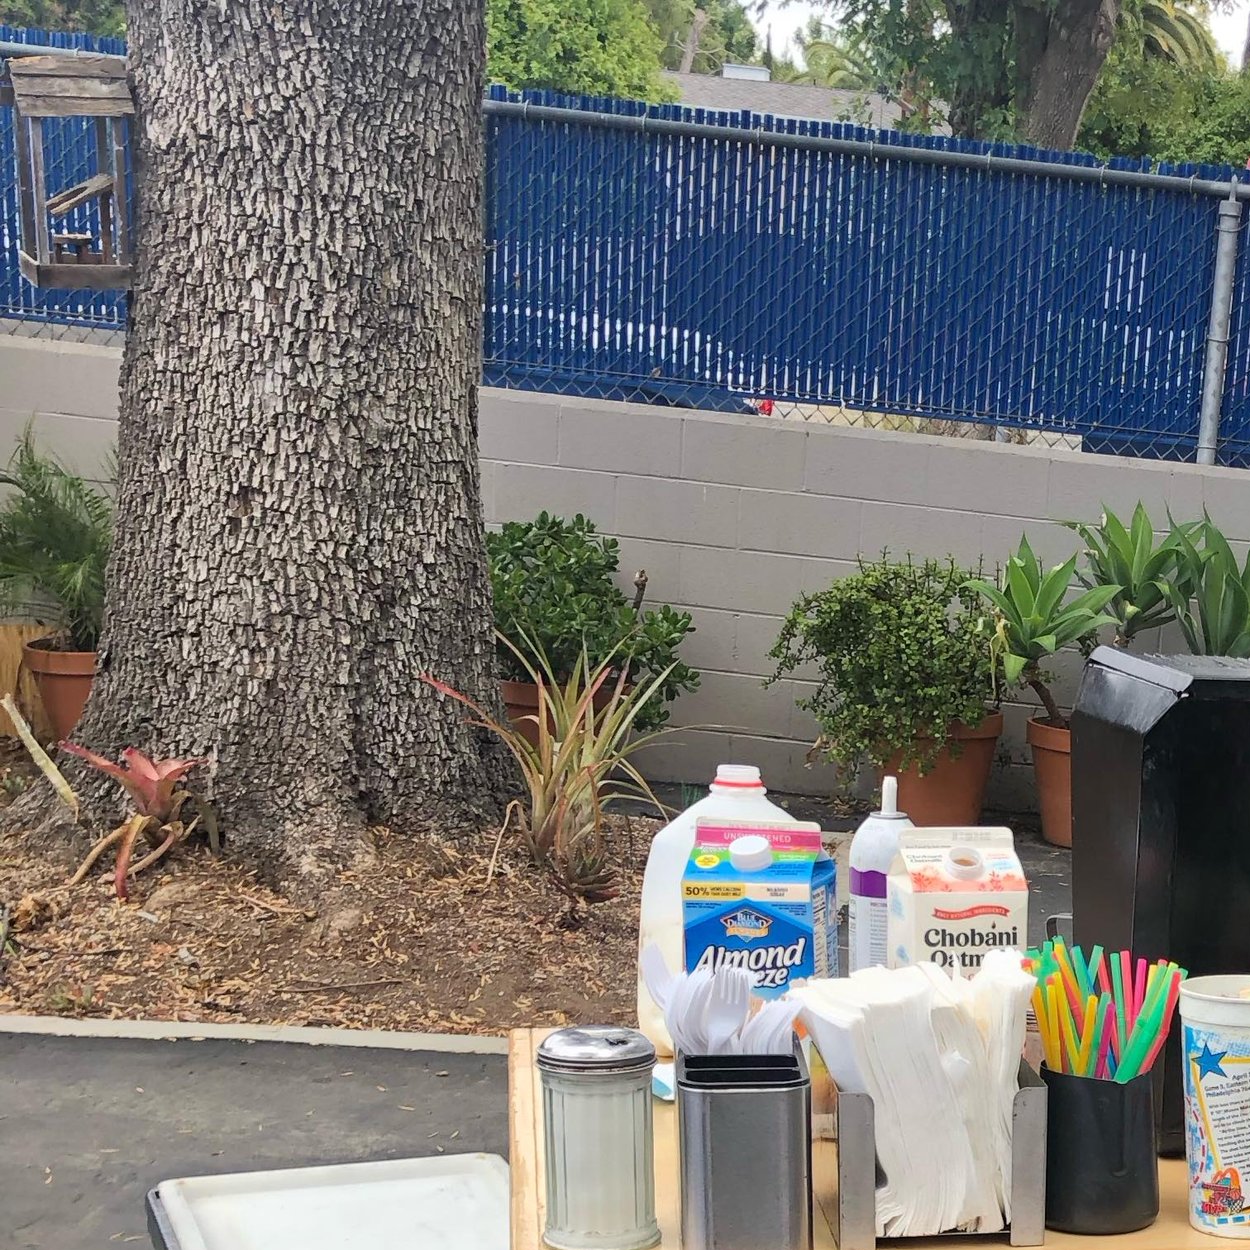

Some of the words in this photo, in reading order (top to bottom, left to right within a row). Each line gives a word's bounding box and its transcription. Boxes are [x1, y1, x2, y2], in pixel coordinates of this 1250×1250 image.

[685, 886, 709, 896] 50%
[736, 912, 755, 921] BLUE
[924, 926, 1018, 948] Chobani
[692, 937, 806, 974] Almond
[754, 967, 790, 988] eze
